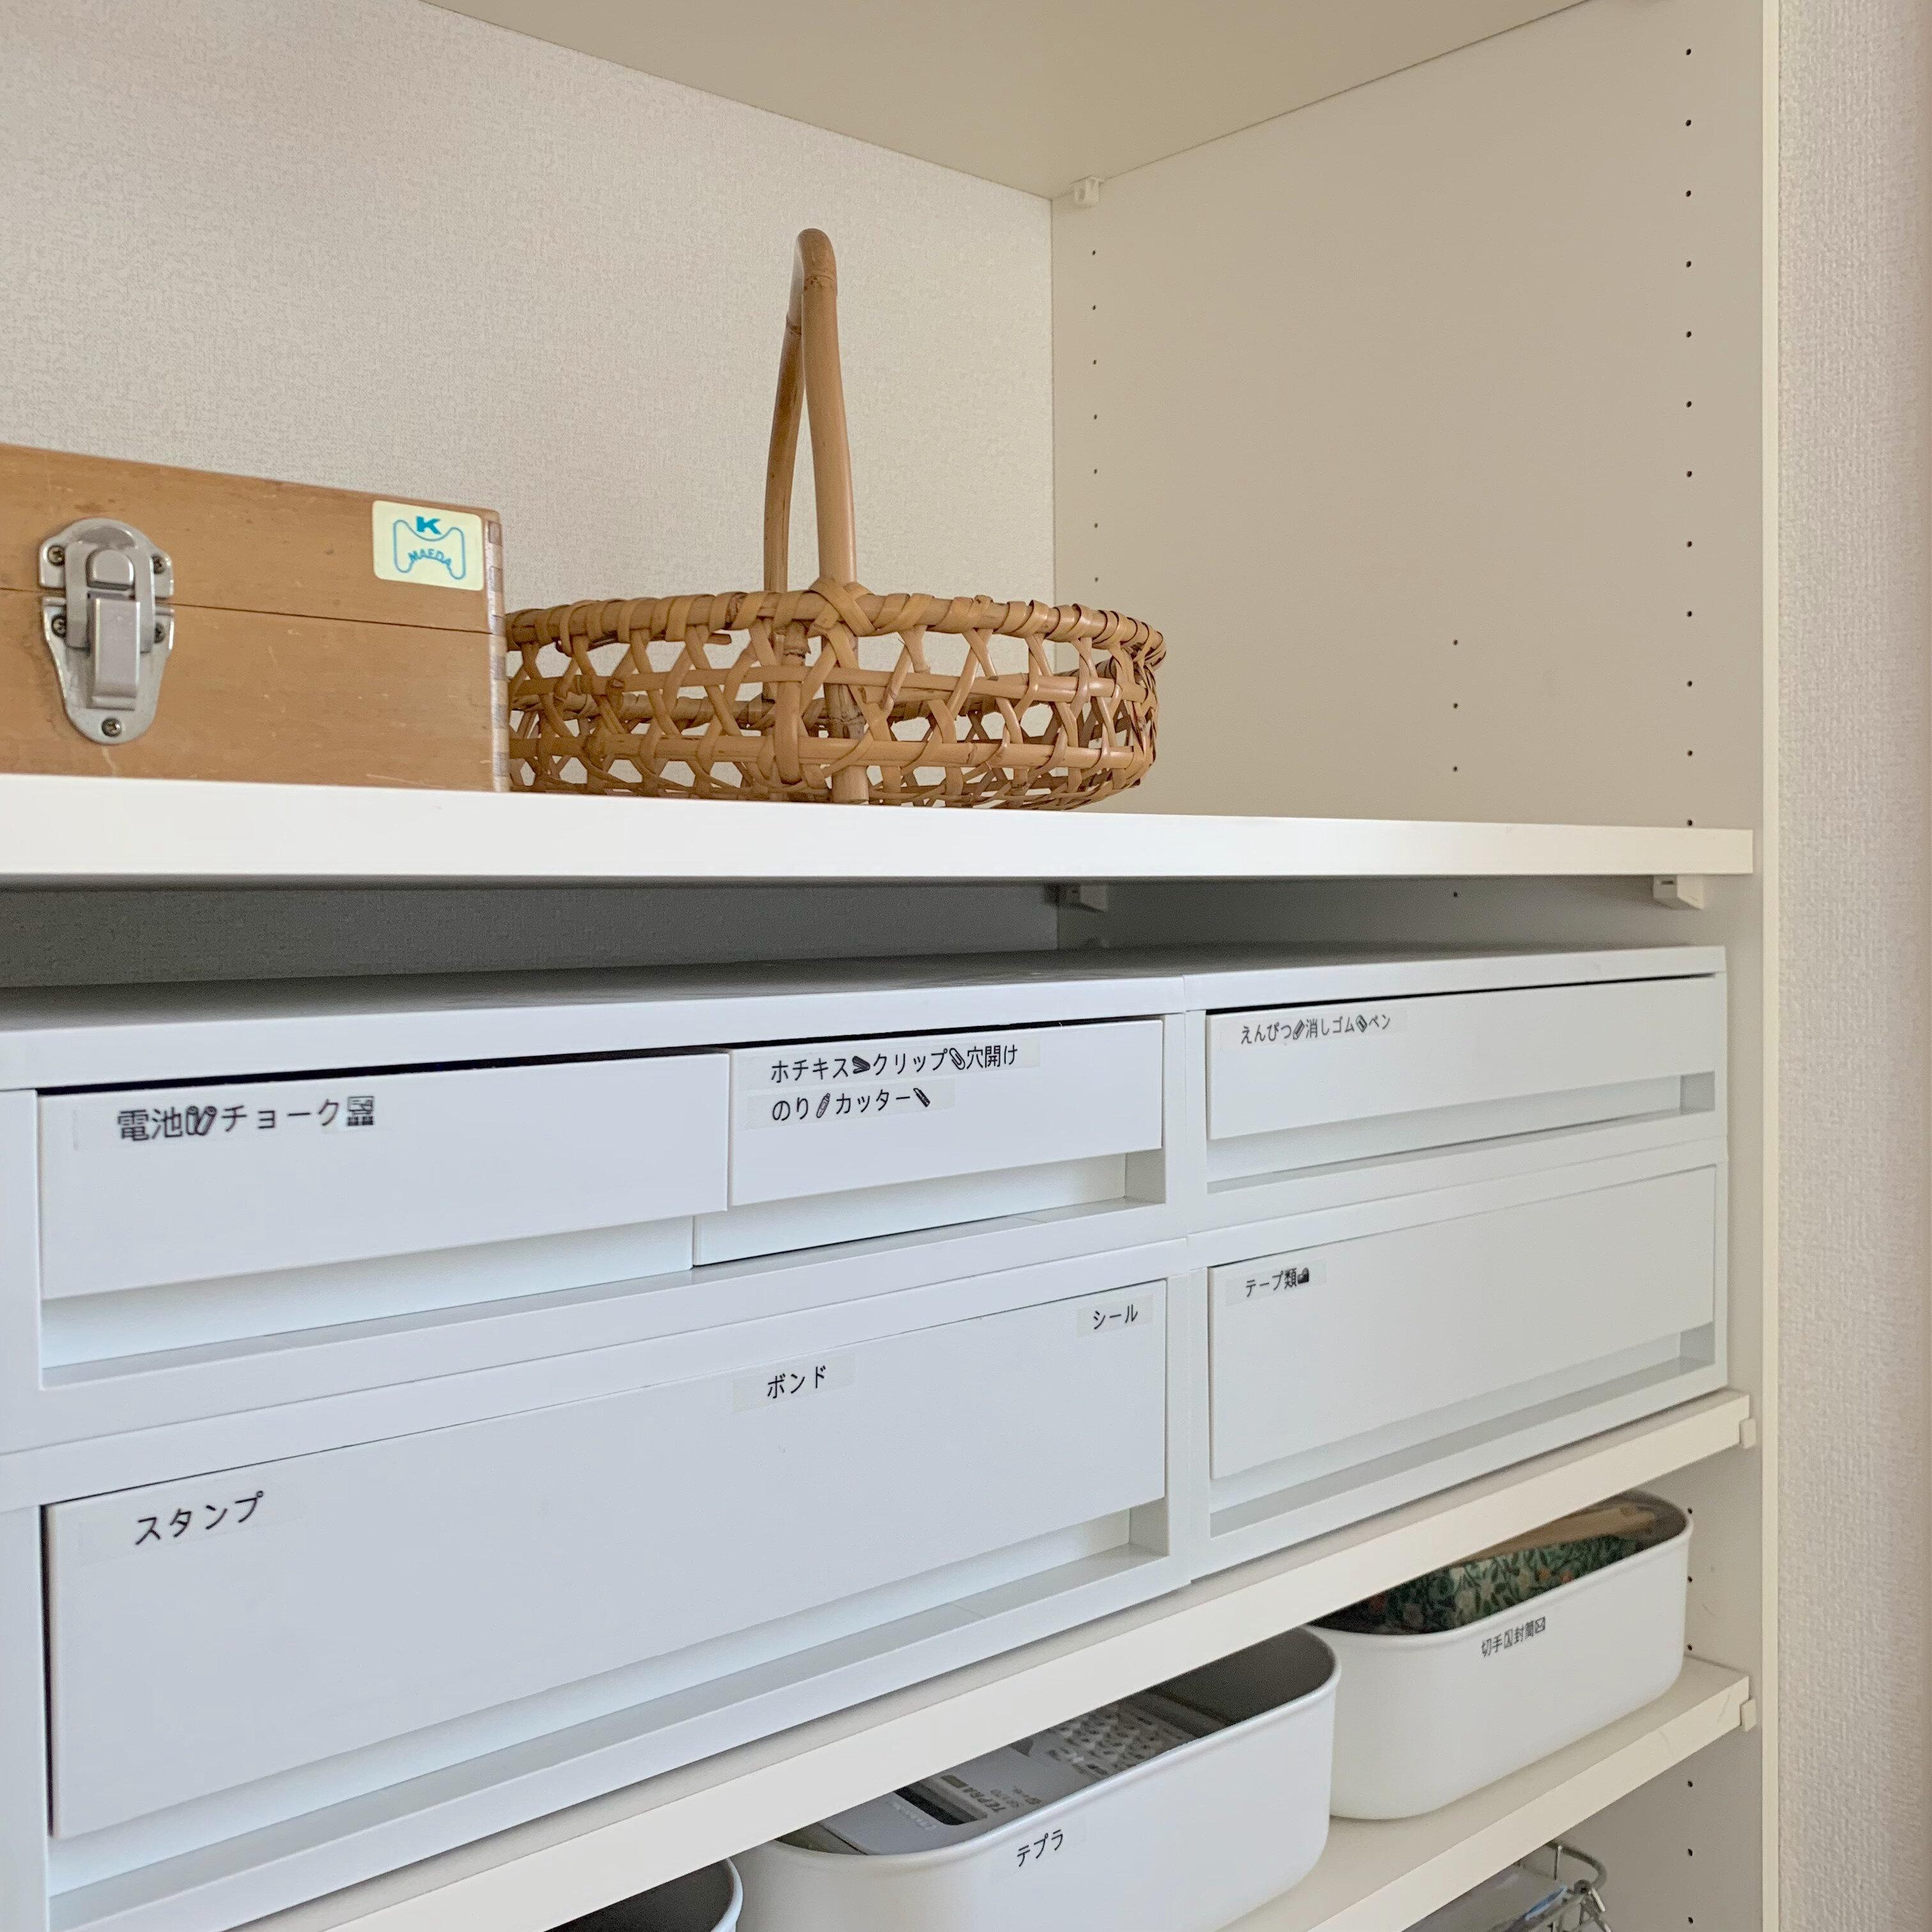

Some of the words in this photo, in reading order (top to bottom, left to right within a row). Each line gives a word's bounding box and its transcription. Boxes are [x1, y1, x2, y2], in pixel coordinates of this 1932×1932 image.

[417, 516, 441, 535] K
[408, 548, 451, 565] MAEDA
[1241, 1022, 1292, 1045] えんぴつ
[1305, 1017, 1355, 1039] 消しゴム
[1368, 1015, 1391, 1030] ペン
[771, 1057, 848, 1084] ホチキス
[873, 1048, 948, 1076] クリップ
[967, 1045, 1018, 1070] 穴開け
[117, 1107, 183, 1142] 電池
[220, 1098, 341, 1132] チョーク
[772, 1098, 809, 1121] のり
[836, 1089, 911, 1115] カッター
[1246, 1267, 1297, 1298] テープ類
[1093, 1304, 1138, 1330] シール
[767, 1365, 826, 1399] ボンド
[135, 1490, 264, 1545] スタンプ
[1482, 1633, 1502, 1657] 切手
[1016, 1828, 1063, 1867] テプラ
